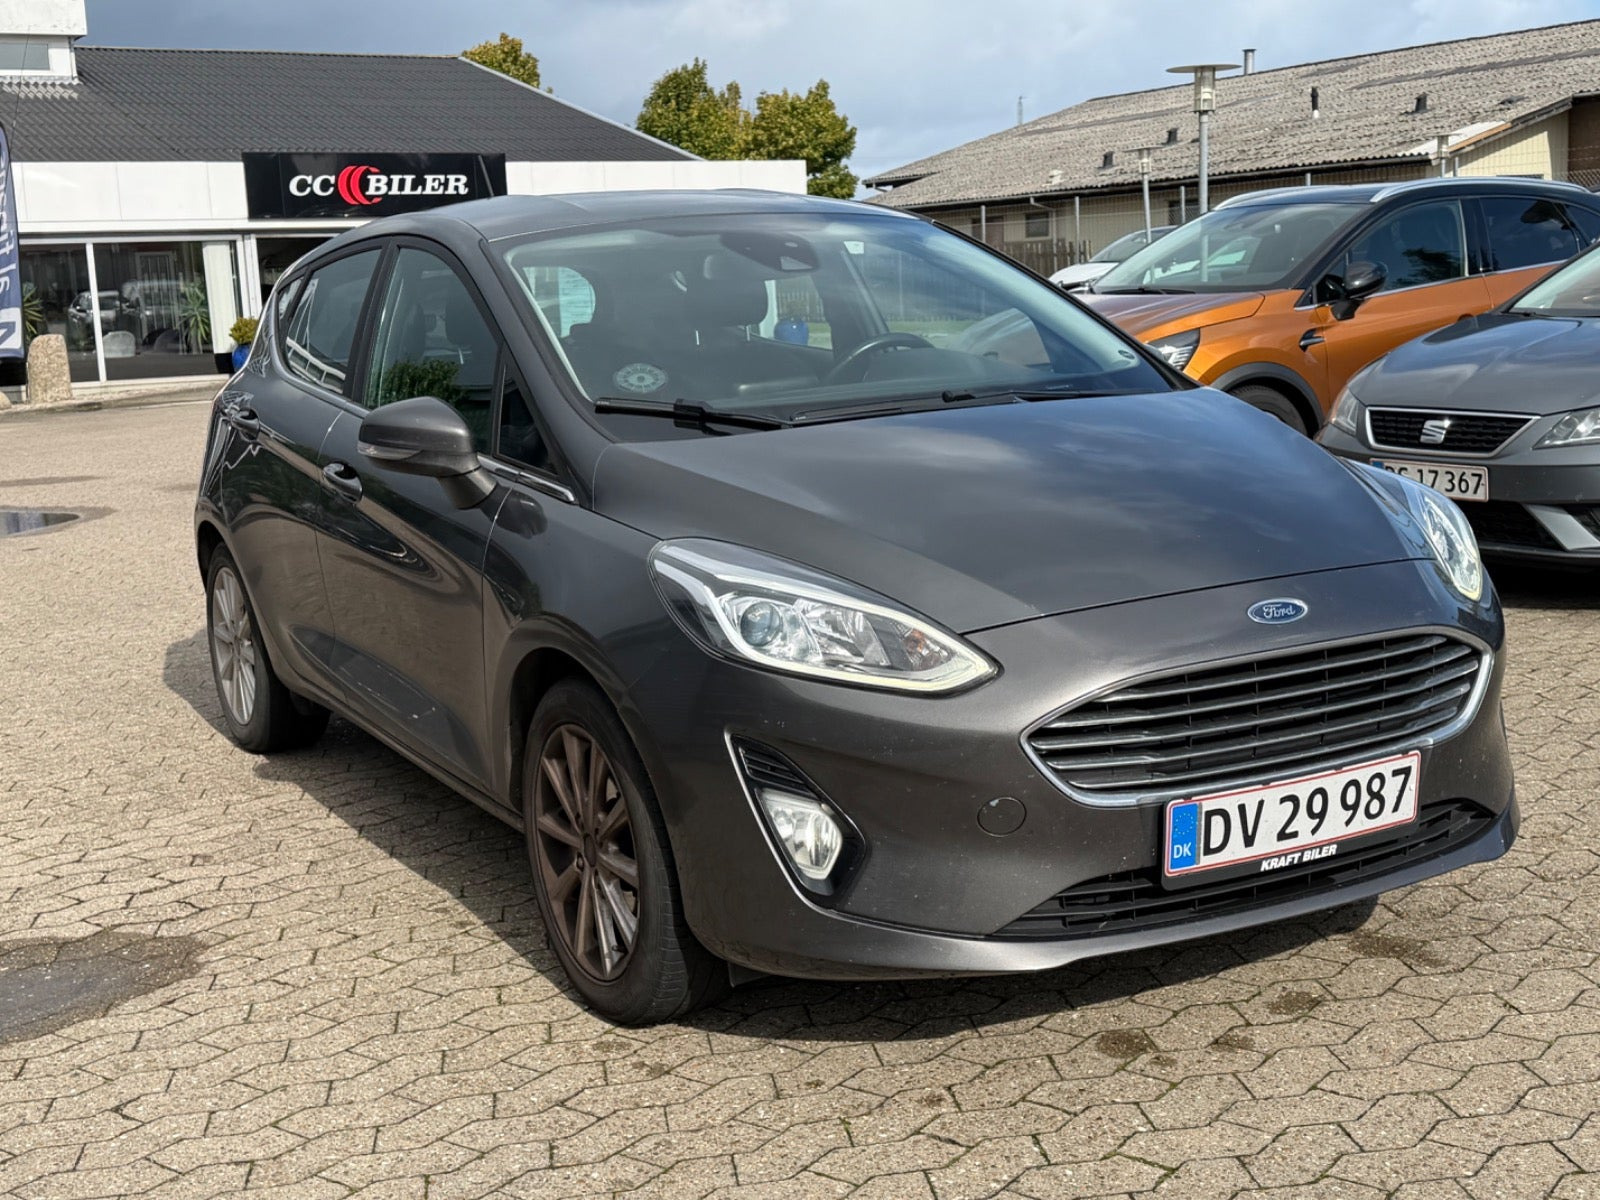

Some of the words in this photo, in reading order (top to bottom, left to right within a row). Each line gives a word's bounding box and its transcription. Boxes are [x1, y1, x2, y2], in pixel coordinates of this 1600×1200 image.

[365, 174, 469, 196] BILER
[1444, 470, 1483, 495] 367
[1262, 604, 1296, 619] Ford
[1202, 799, 1265, 857] DV
[1276, 787, 1329, 842] 29
[1340, 765, 1413, 828] 987
[1173, 842, 1192, 859] DK
[1260, 853, 1302, 872] KRAFT
[1302, 844, 1338, 863] BILER
